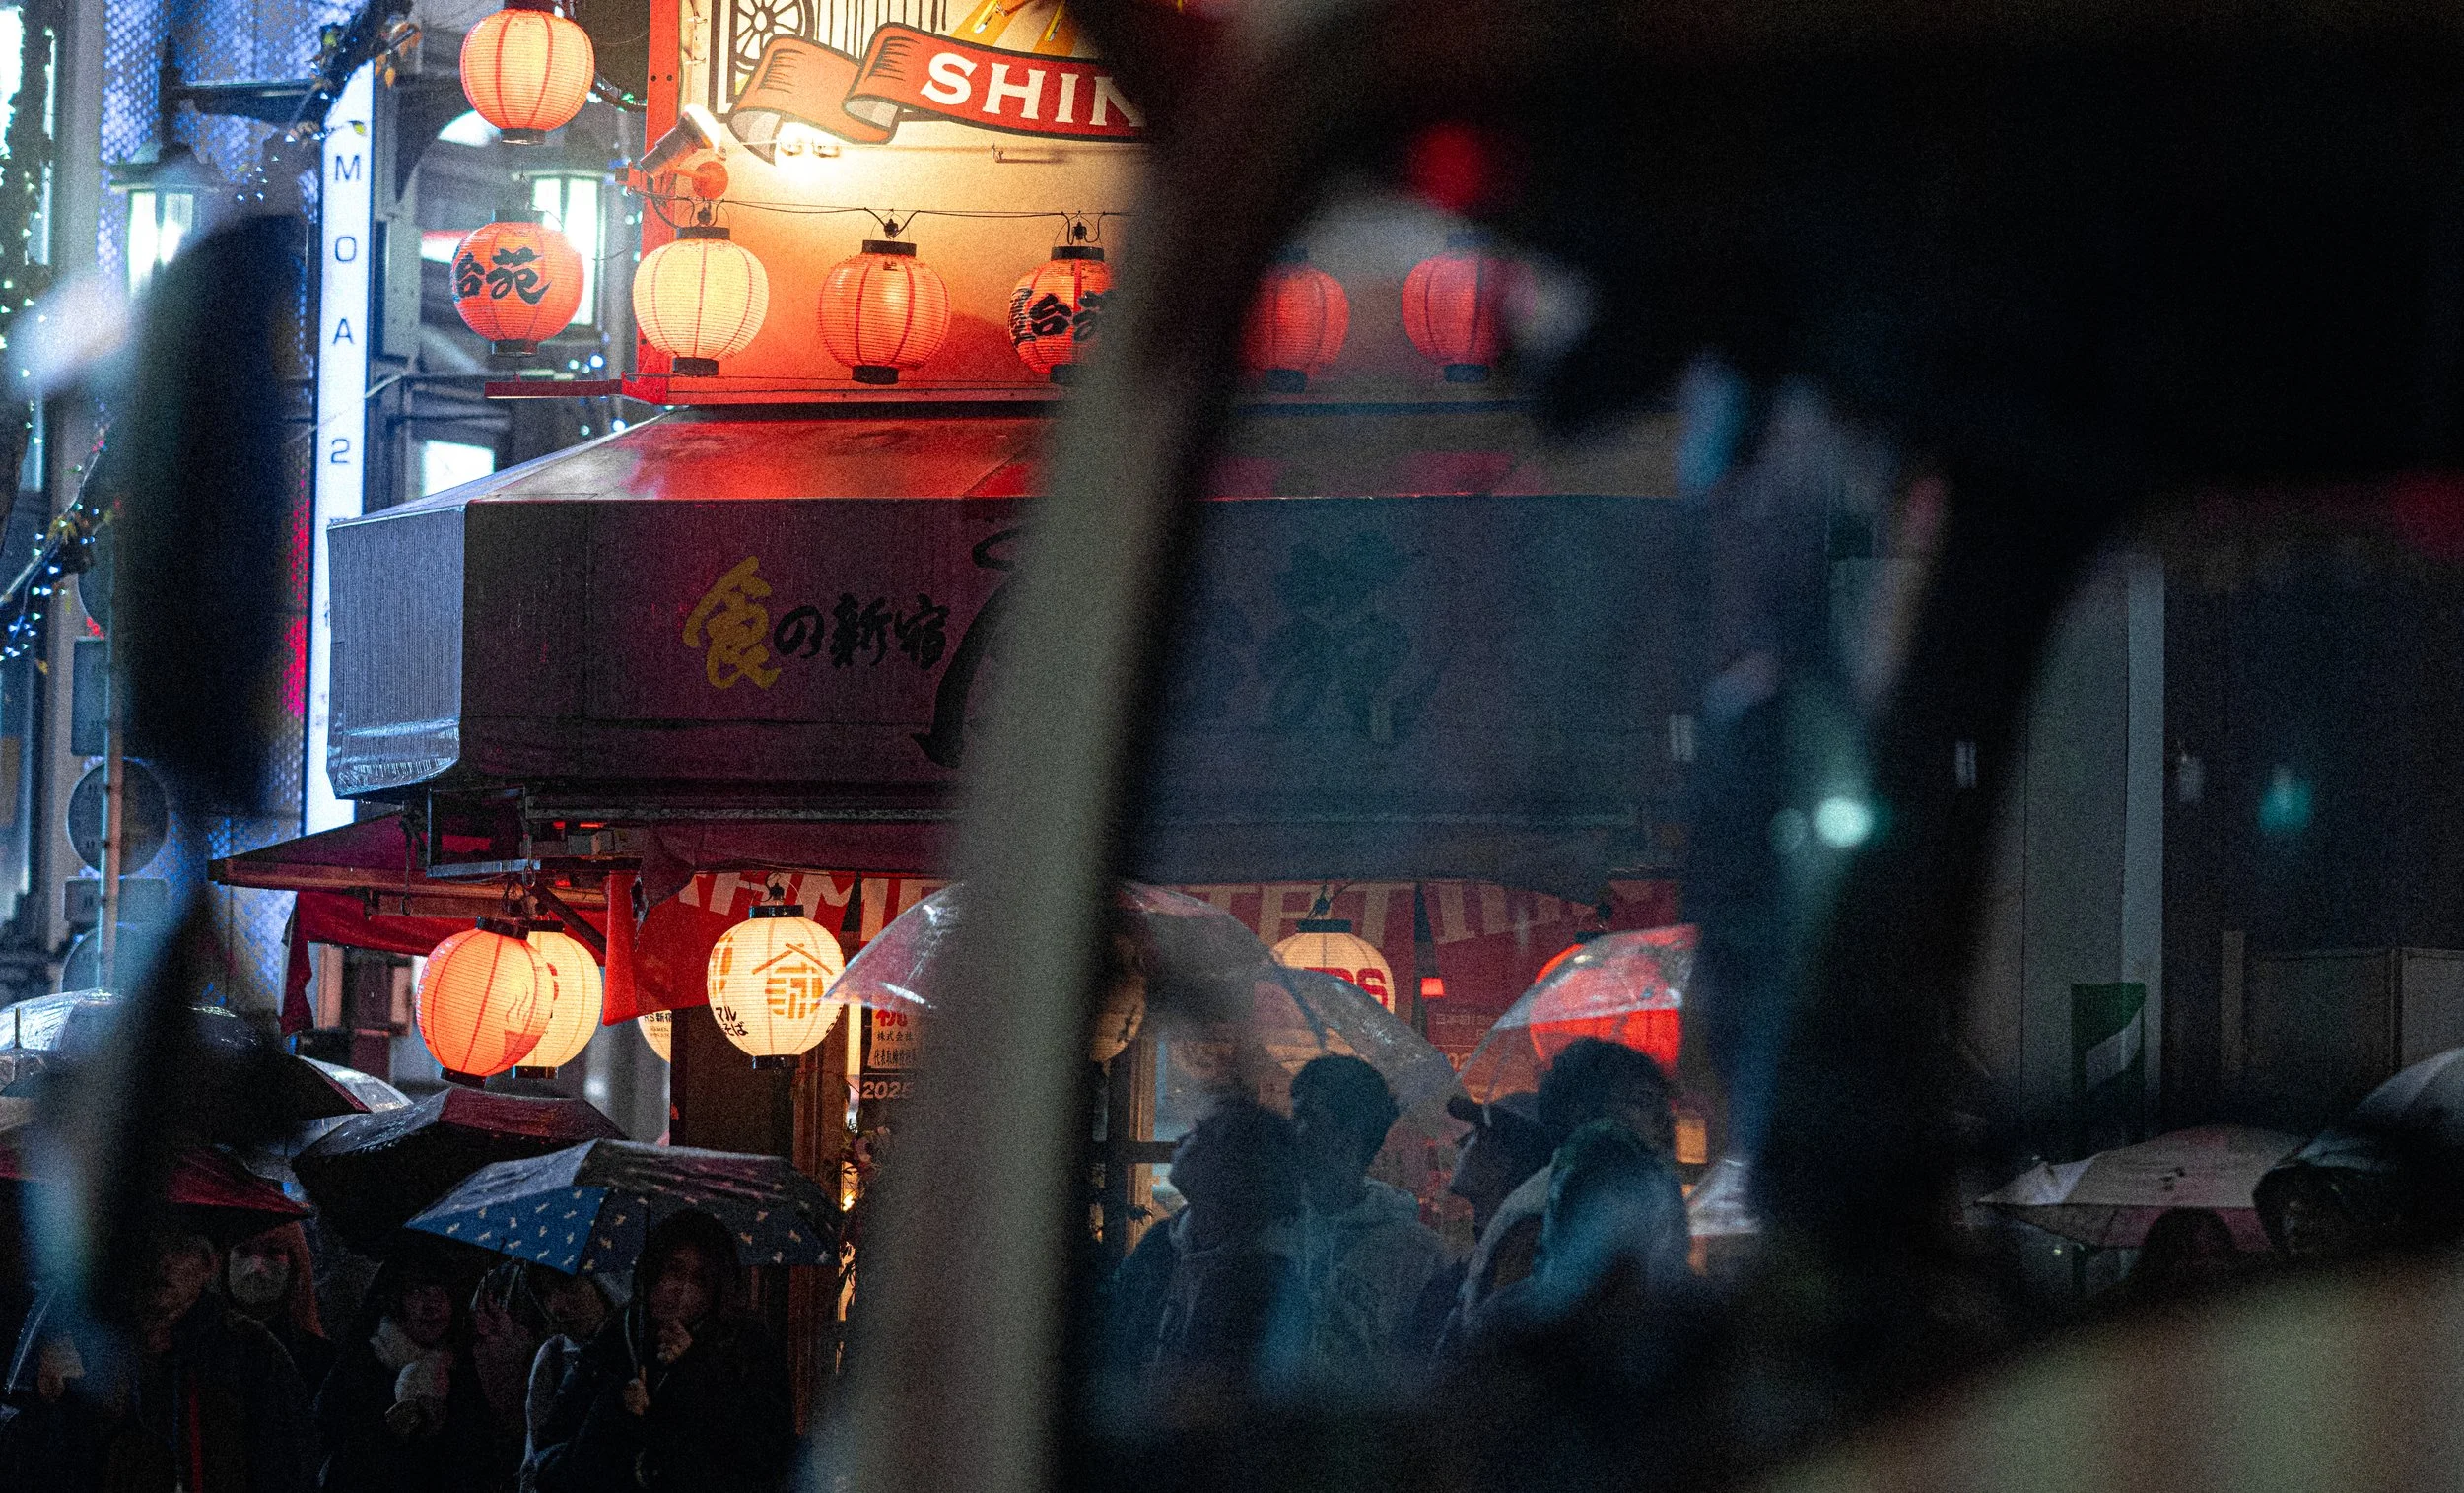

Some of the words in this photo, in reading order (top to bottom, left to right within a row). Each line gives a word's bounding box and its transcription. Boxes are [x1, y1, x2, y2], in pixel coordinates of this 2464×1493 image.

[920, 52, 1144, 127] SHIN
[452, 246, 553, 305] 台苑
[682, 555, 949, 690] 食の新宿
